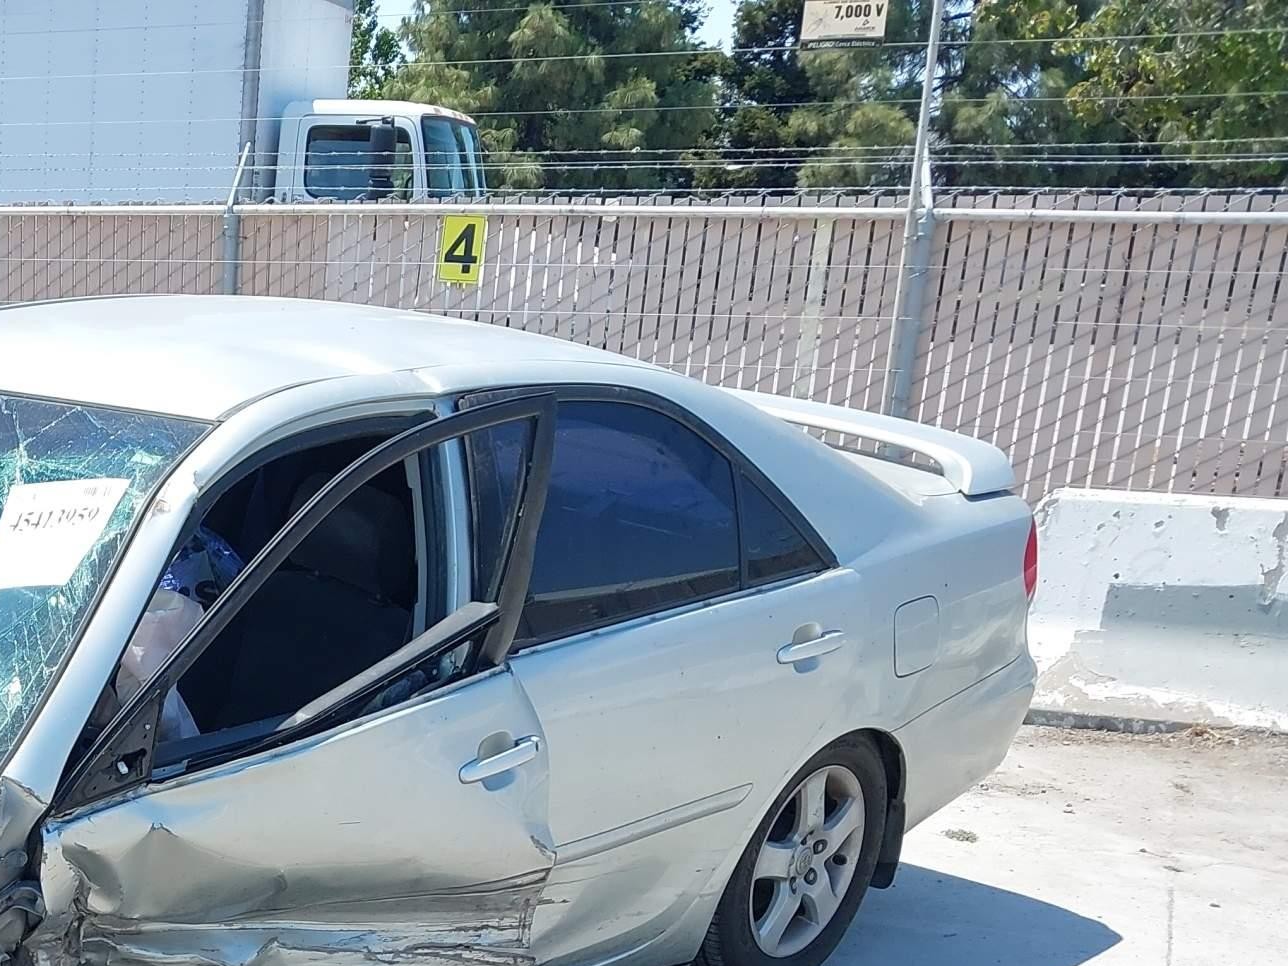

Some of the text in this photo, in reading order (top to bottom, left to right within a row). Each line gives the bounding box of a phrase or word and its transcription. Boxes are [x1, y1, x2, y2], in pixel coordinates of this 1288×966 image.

[834, 3, 884, 20] 7,000 V
[444, 223, 478, 273] 4
